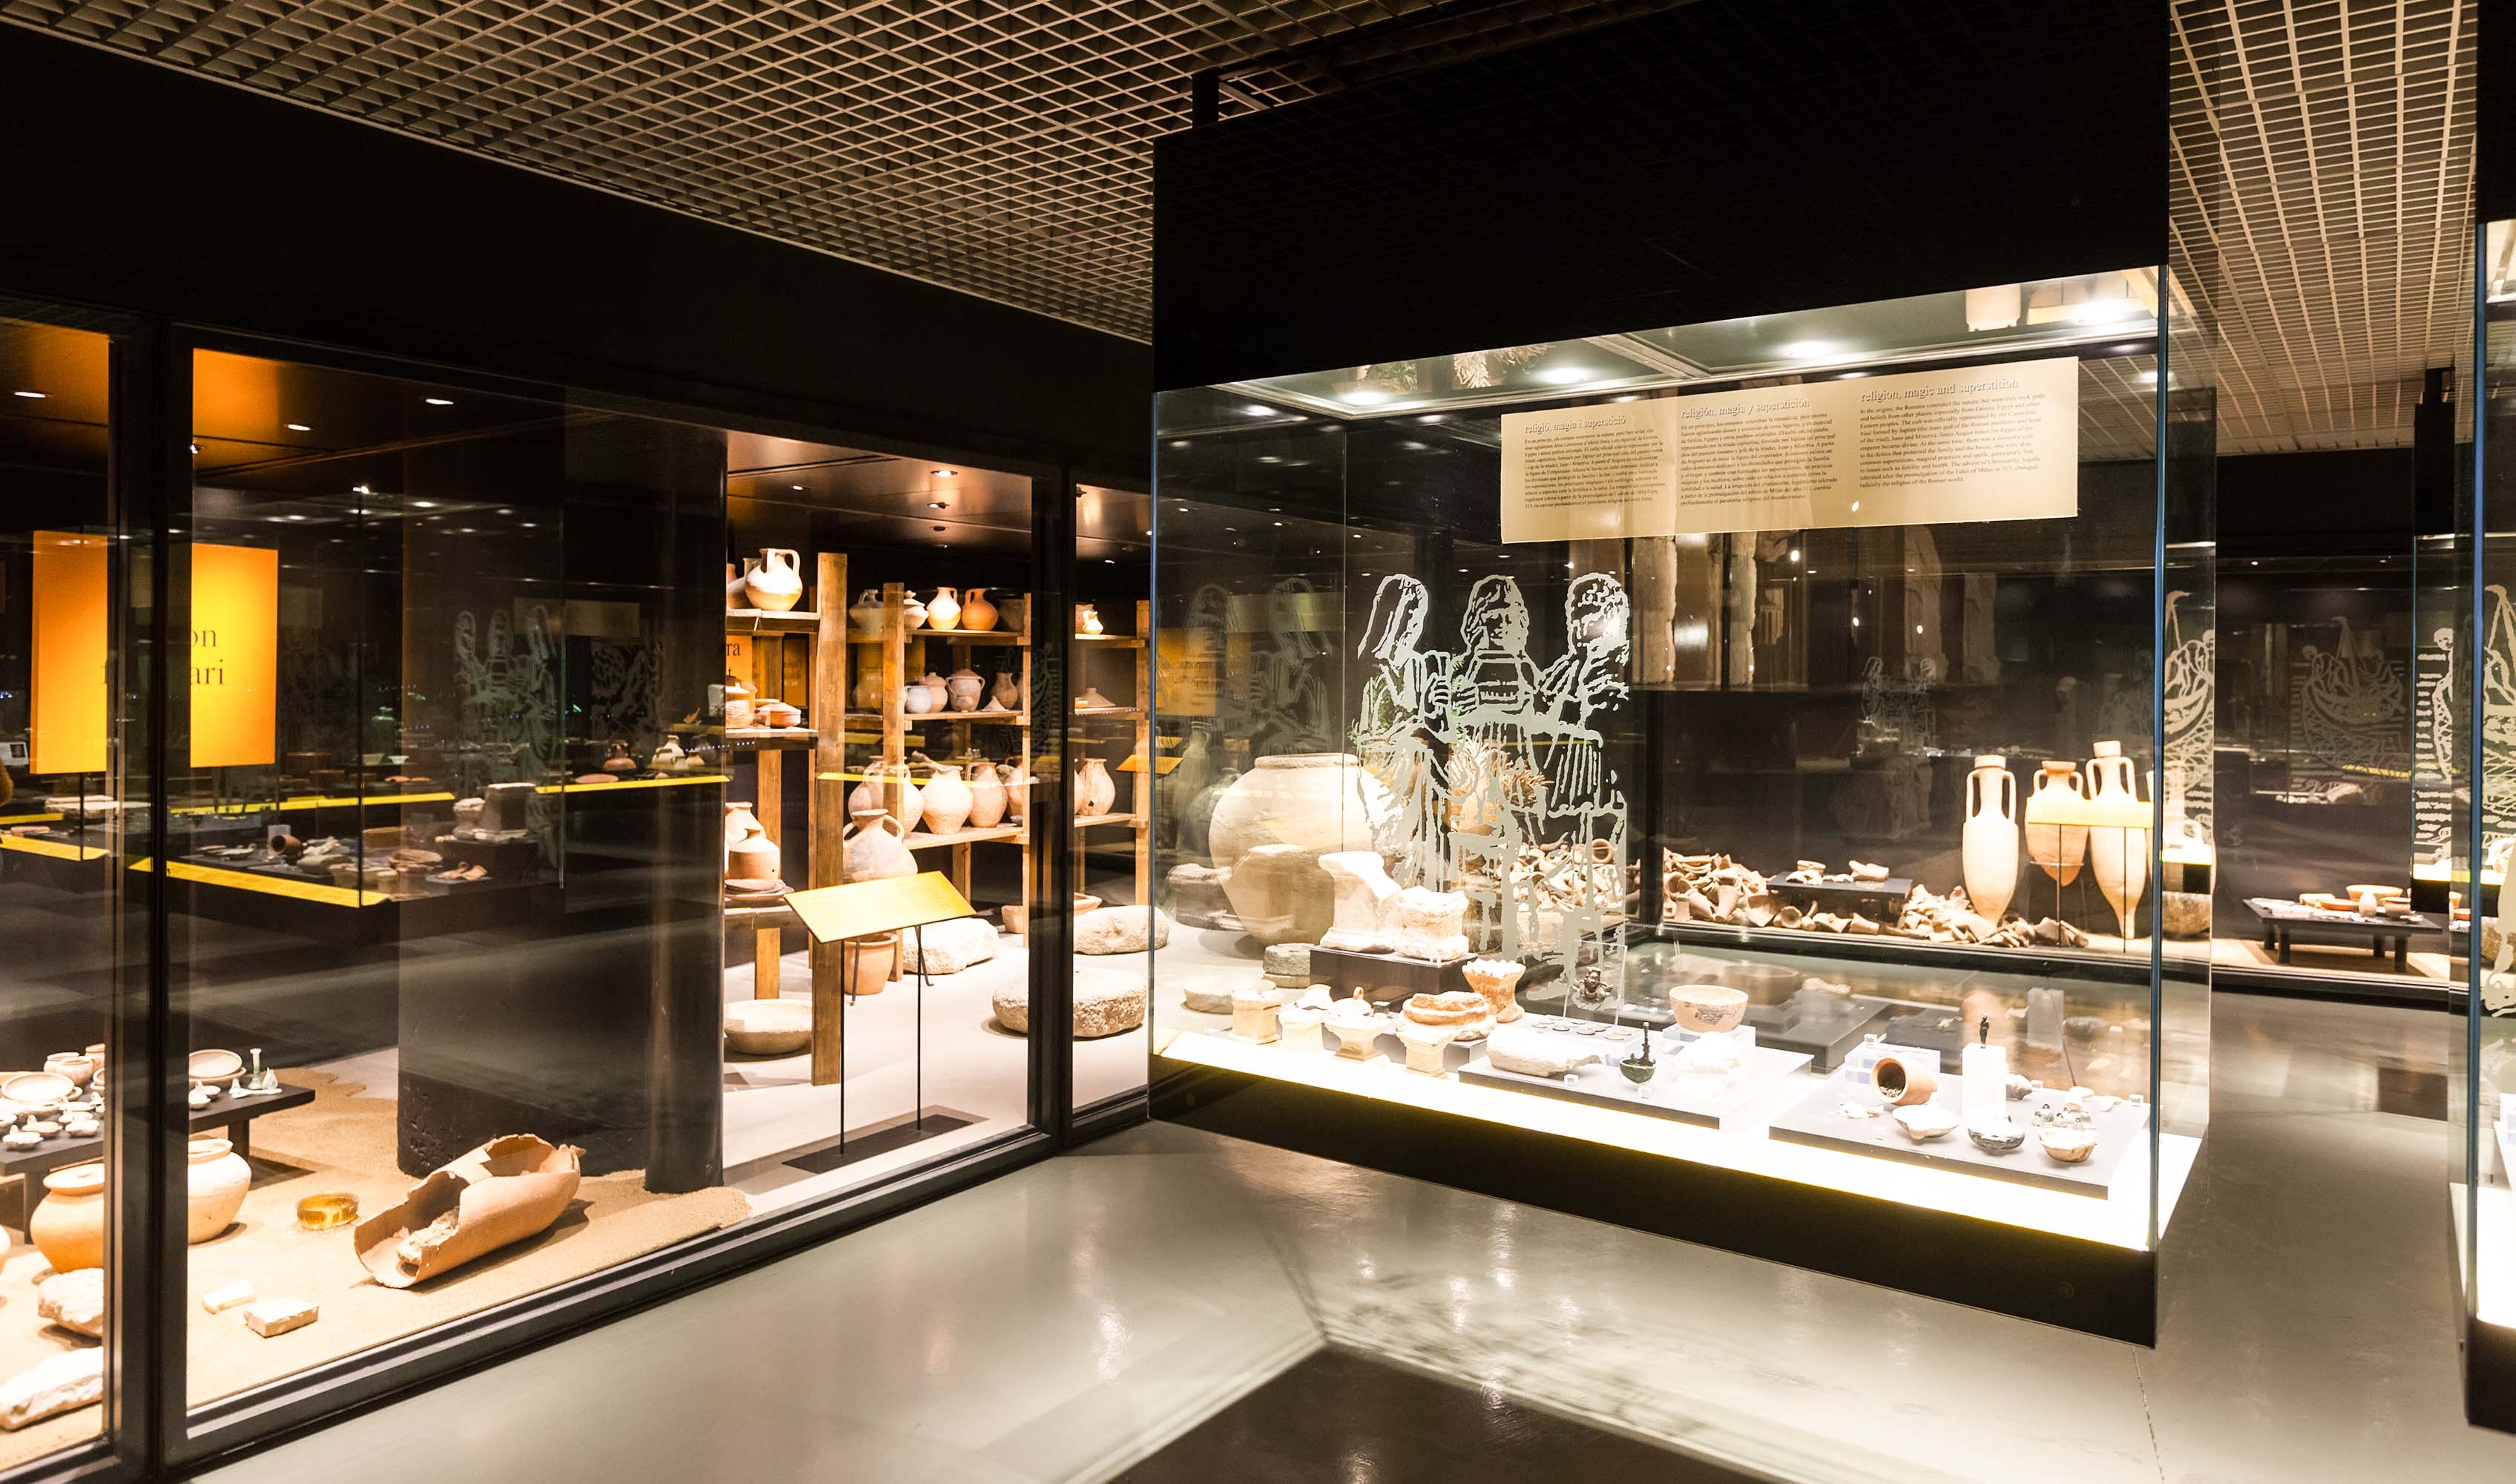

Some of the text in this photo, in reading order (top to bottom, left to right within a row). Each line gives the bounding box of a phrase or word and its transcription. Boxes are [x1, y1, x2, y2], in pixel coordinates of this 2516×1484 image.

[1862, 378, 2019, 404] religion, magic and superstition
[1681, 407, 1717, 420] religión,
[1719, 404, 1746, 417] magia
[1756, 398, 1810, 413] superstición
